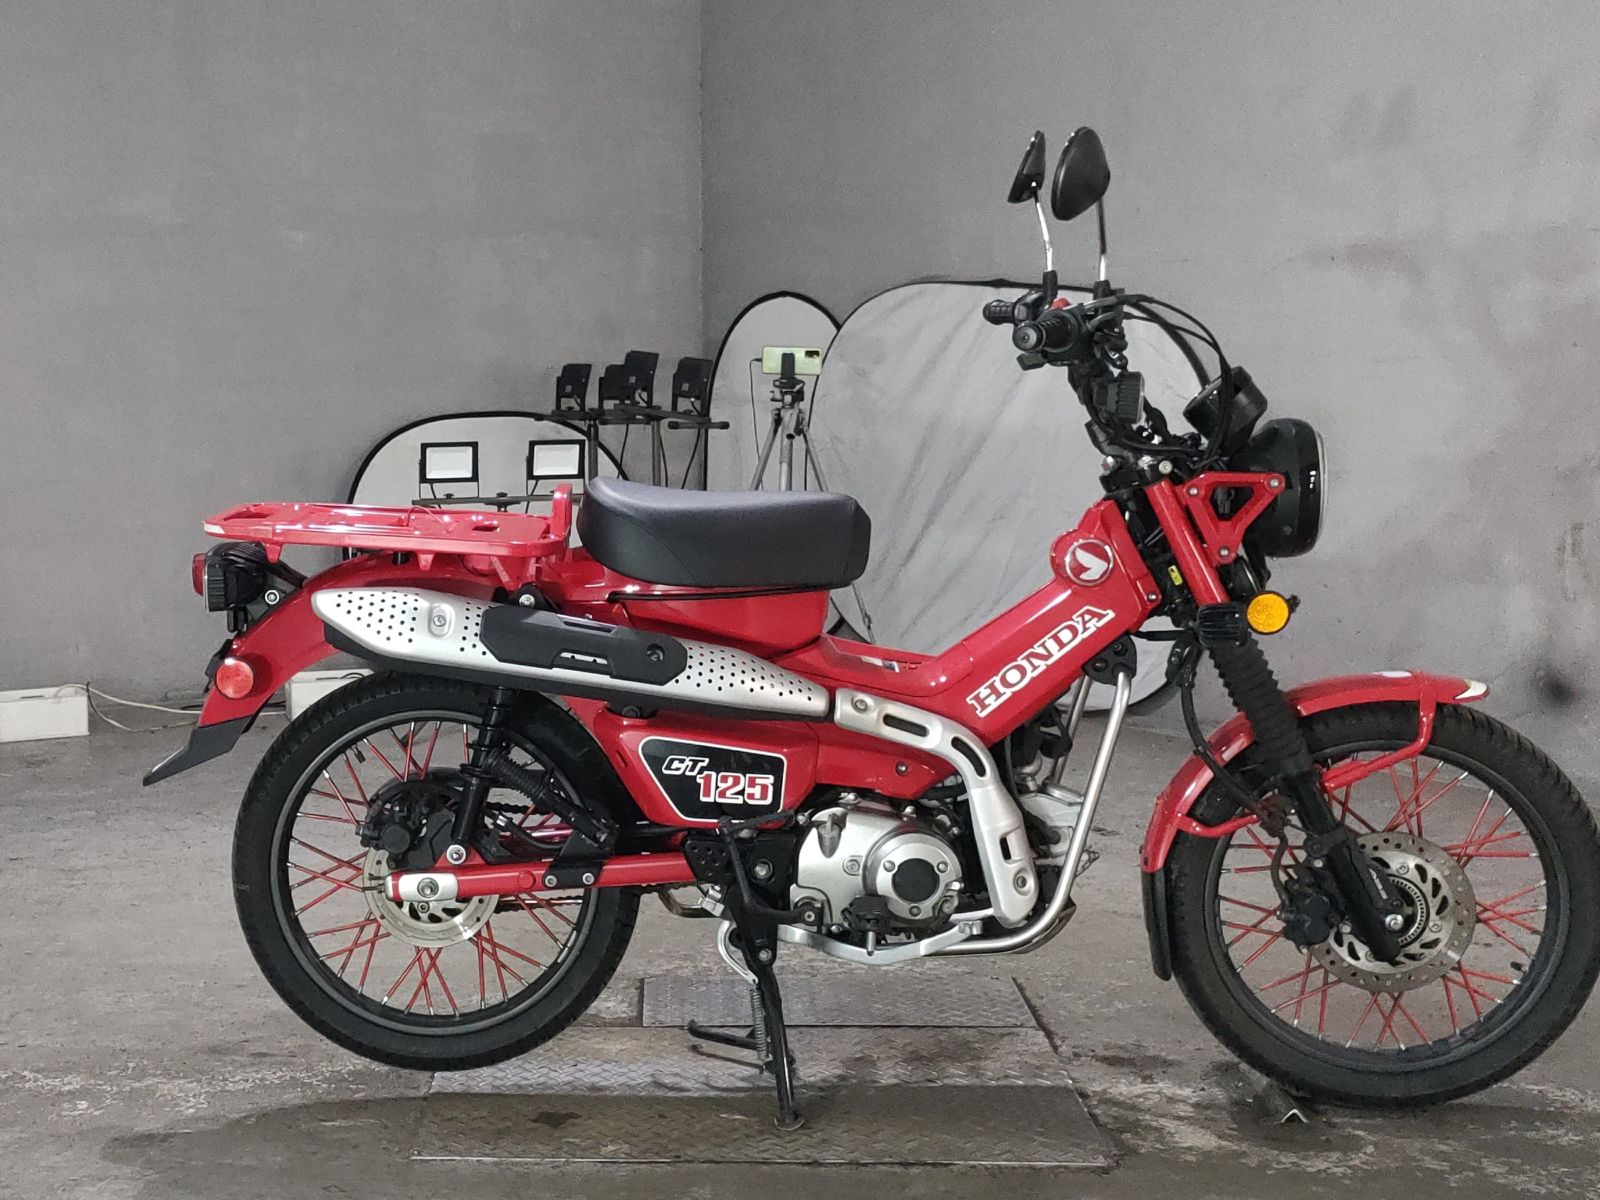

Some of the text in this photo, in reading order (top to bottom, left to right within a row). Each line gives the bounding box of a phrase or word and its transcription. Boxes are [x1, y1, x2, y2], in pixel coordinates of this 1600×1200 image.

[966, 605, 1115, 718] HONDA
[662, 755, 709, 776] CT
[696, 771, 774, 805] 125
